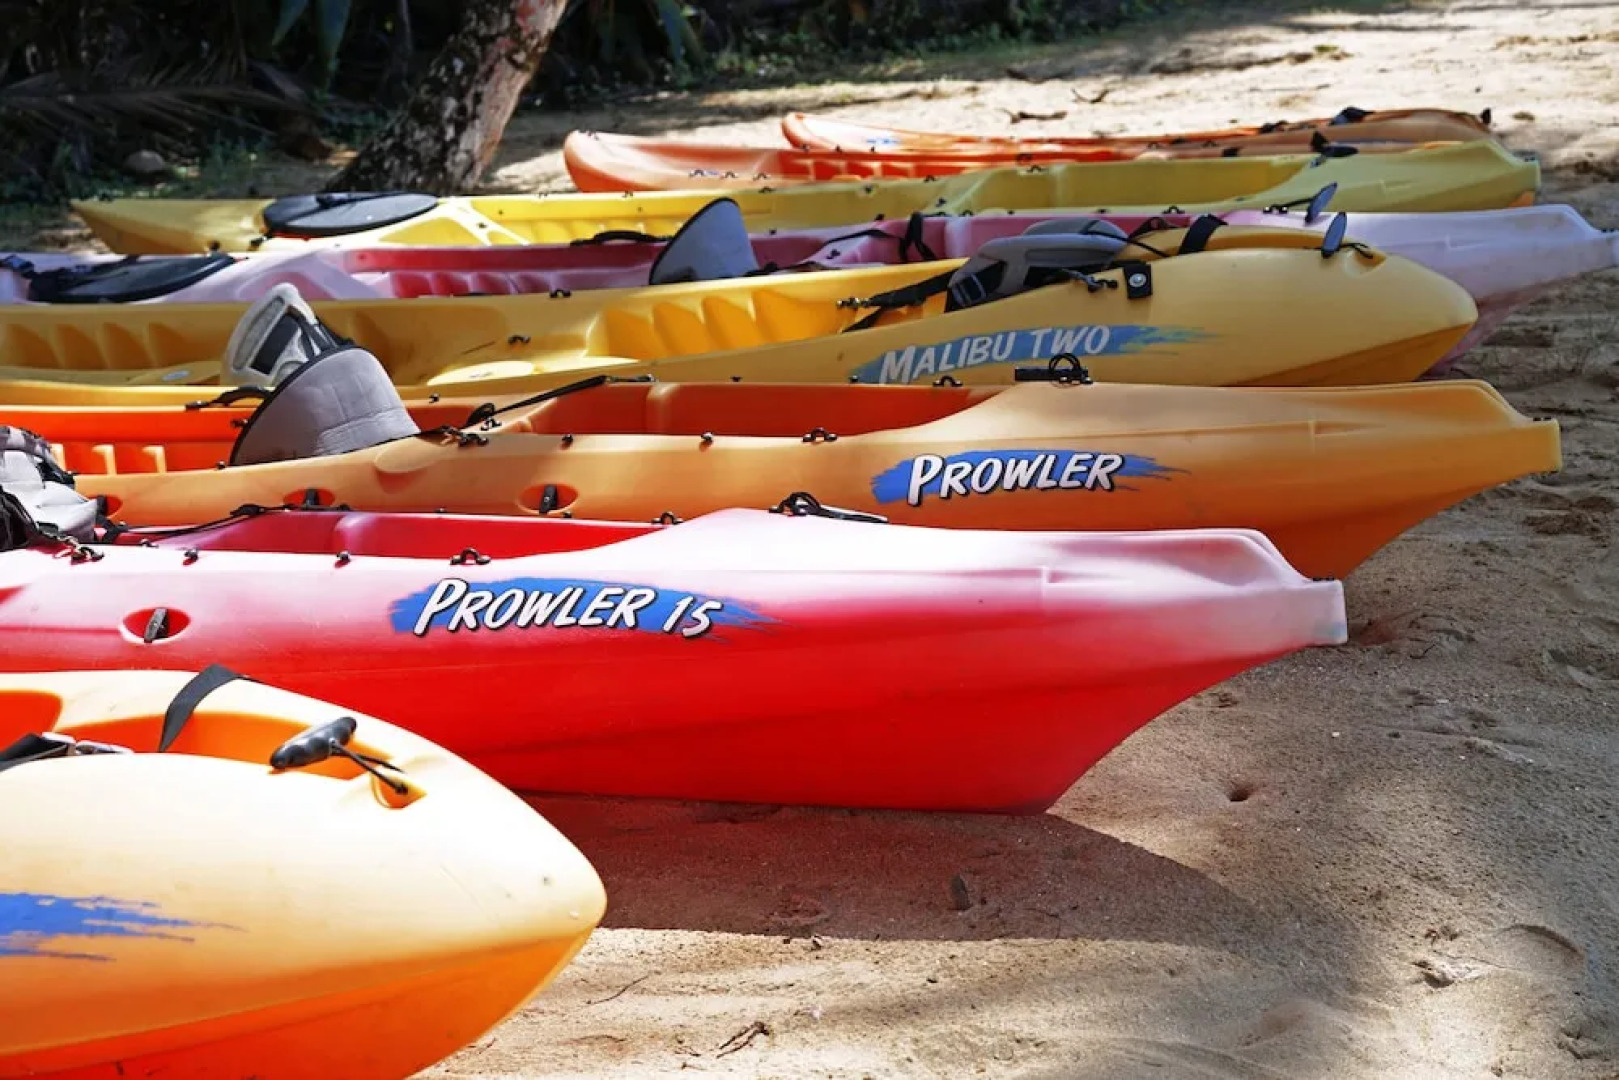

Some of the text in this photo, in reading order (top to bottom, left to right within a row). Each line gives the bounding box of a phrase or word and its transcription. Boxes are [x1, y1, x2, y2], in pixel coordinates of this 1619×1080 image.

[879, 325, 1111, 384] MALIBU TWO
[907, 453, 1125, 507] PROWLER
[413, 578, 723, 637] PROWLER 15
